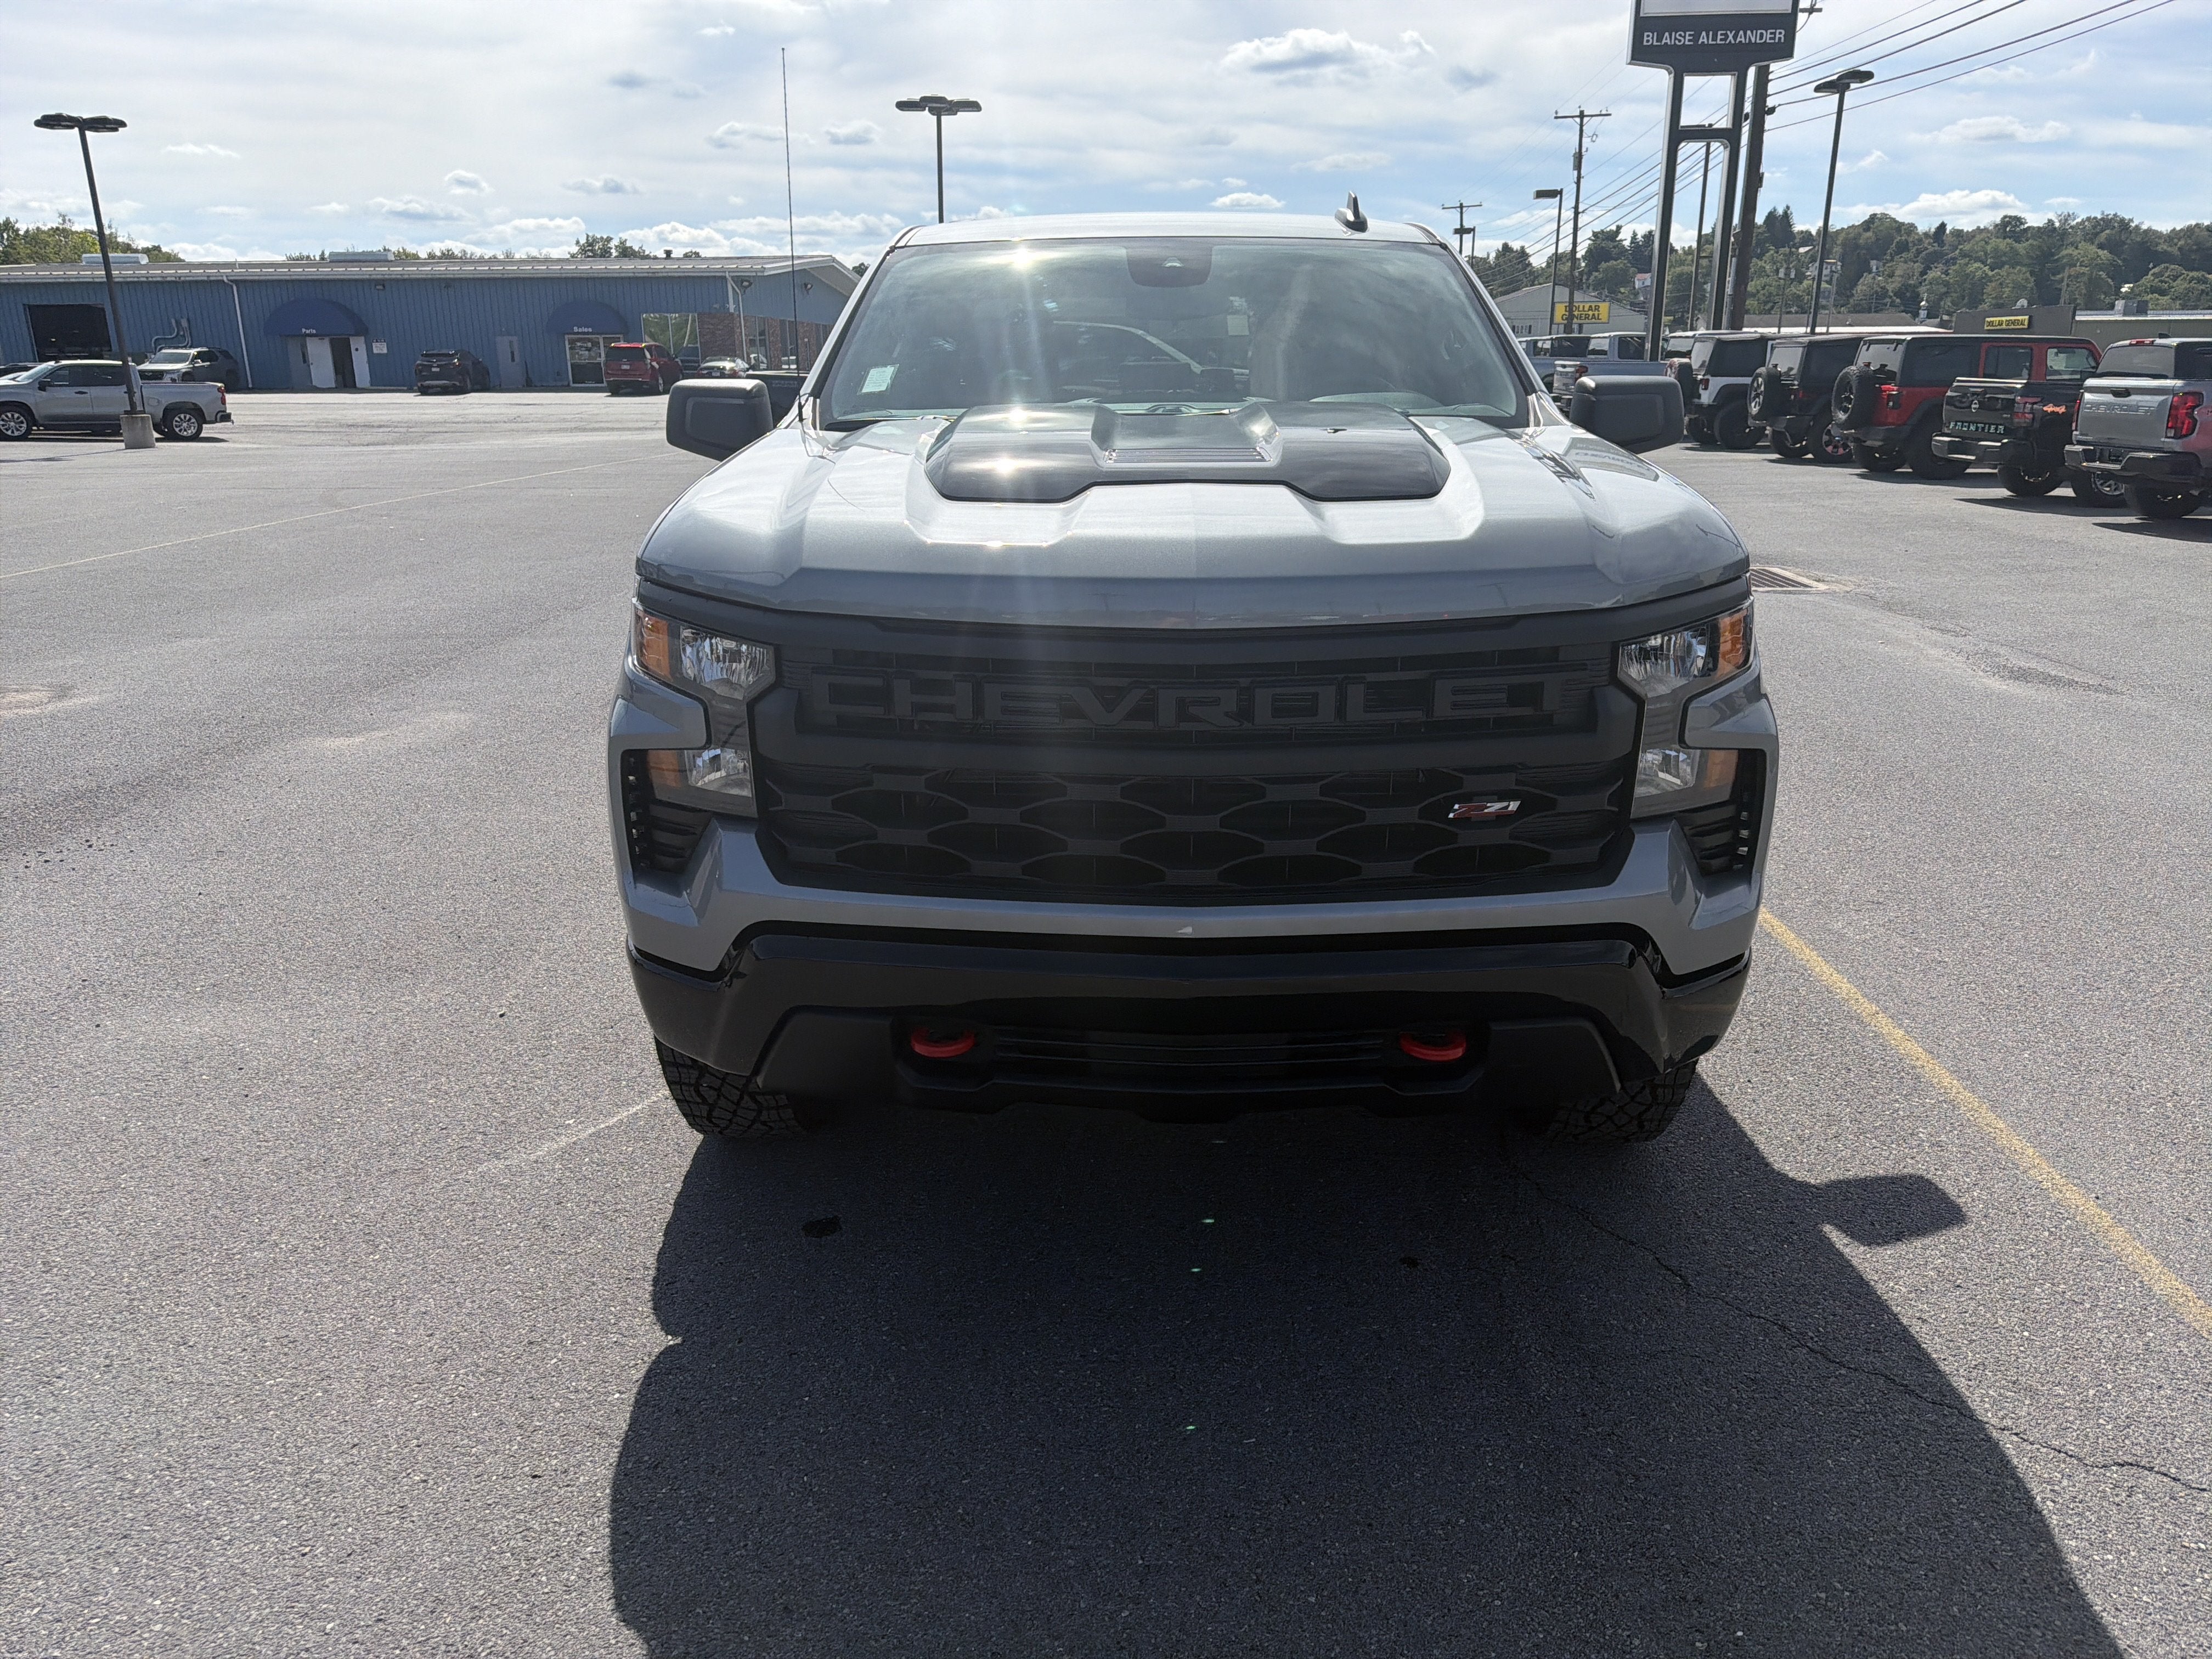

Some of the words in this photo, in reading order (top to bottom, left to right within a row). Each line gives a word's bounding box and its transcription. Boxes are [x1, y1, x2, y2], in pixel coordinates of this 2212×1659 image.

[1643, 31, 1695, 46] BLAISE
[1698, 29, 1786, 44] ALEXANDER
[1561, 313, 1602, 321] GNERAL
[1985, 319, 2004, 328] DOLLAR
[1949, 421, 2005, 434] FRONTIER
[811, 668, 1575, 729] CHEVROLET
[1448, 800, 1521, 819] Z71
